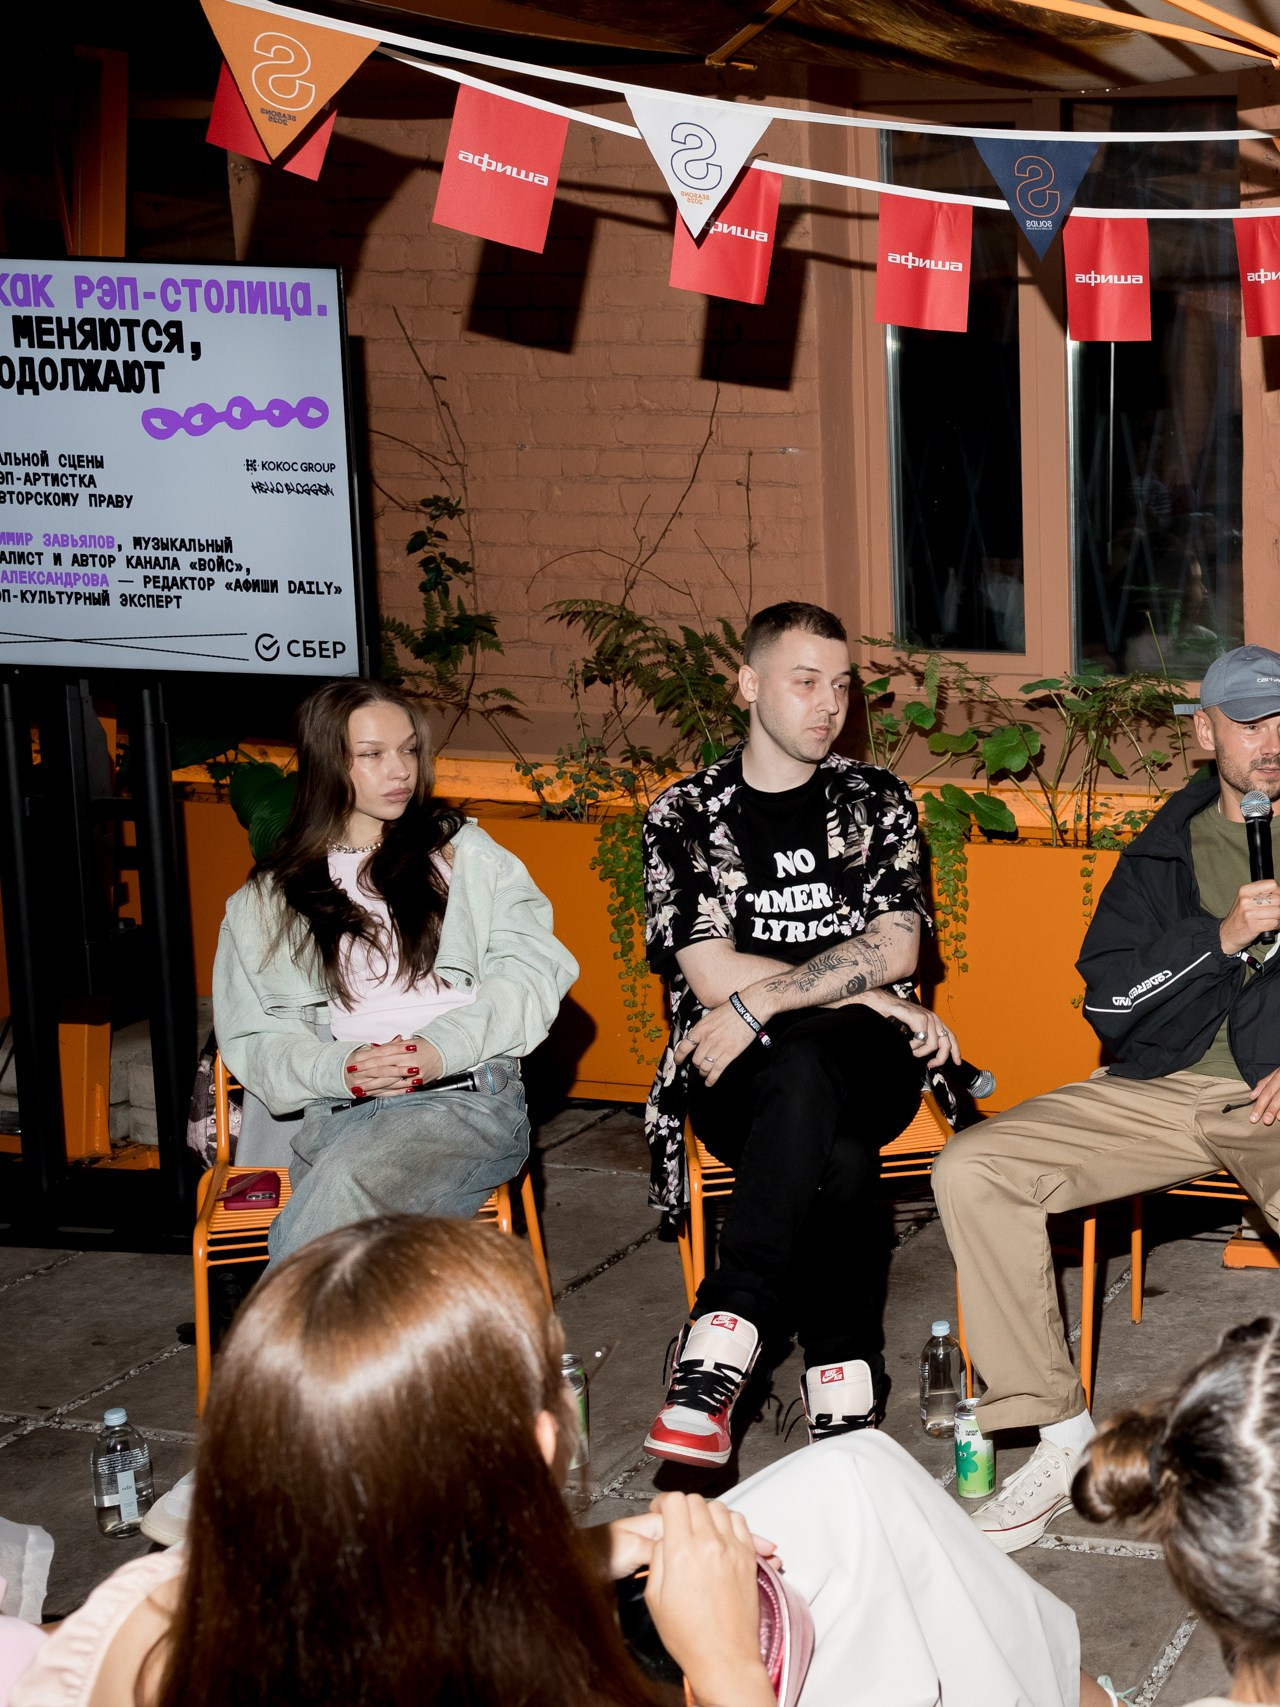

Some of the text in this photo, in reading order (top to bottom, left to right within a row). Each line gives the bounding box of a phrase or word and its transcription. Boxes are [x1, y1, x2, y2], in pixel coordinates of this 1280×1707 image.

[458, 149, 549, 187] афиша
[703, 217, 769, 243] фиша
[887, 251, 963, 272] афиша
[1075, 270, 1144, 287] афиша
[12, 314, 202, 361] МЕНЯЮТСЯ,
[58, 453, 105, 471] СЦЕНЫ
[261, 461, 336, 473] KOKOC GROUP
[88, 493, 133, 508] ПРАВУ
[43, 532, 122, 552] ЗАВЬЯЛОВ,
[132, 536, 233, 553] МУЗЫКАЛЬНЫЙ
[53, 553, 62, 566] И
[71, 553, 116, 568] АВТОР
[126, 555, 181, 571] КАНАЛА
[189, 556, 251, 575] «ВОЙС»,
[0, 570, 343, 595] АЛЕКСАНДРОВА РЕДАКТОР «АФИШИ DAILY»
[0, 589, 182, 609] П-КУЛЬТУРНЫЙ ЭКСПЕРТ
[287, 639, 347, 659] СБЕР
[773, 848, 816, 878] NO
